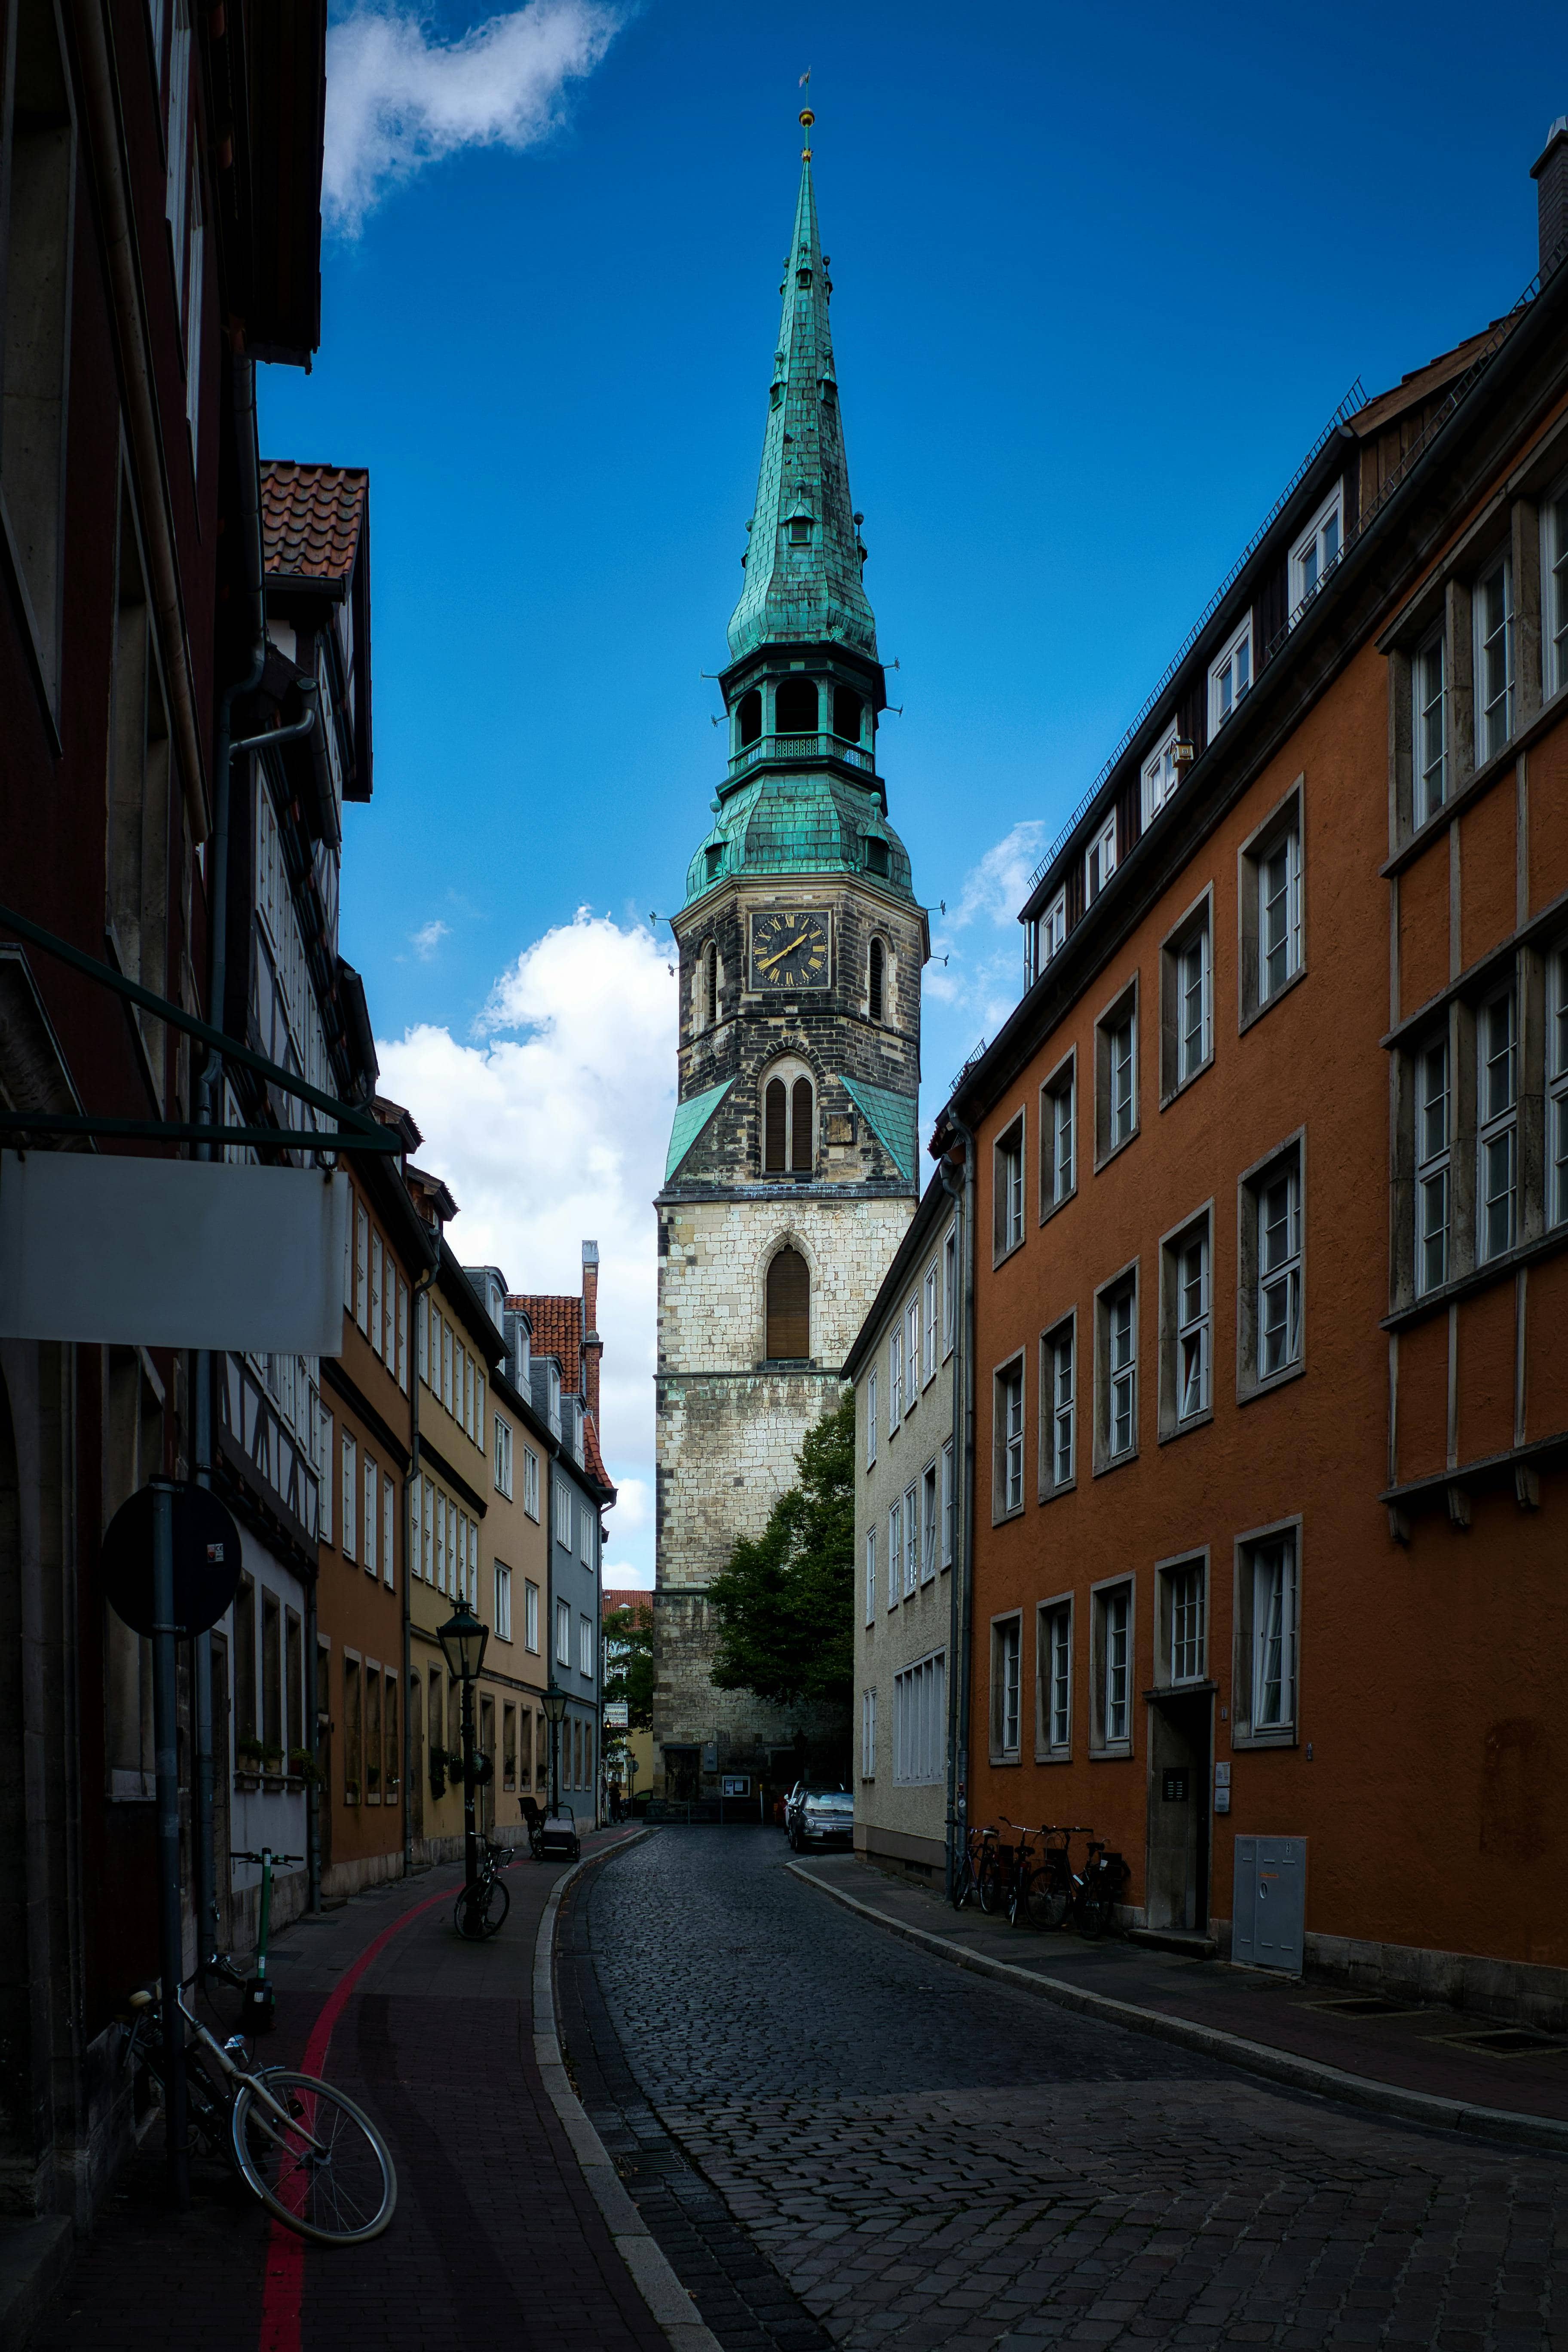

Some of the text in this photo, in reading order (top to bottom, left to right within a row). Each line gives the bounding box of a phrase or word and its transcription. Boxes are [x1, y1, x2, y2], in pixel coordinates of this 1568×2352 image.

[769, 919, 781, 933] XI
[785, 914, 794, 928] XII
[801, 918, 809, 930] I
[758, 929, 772, 941] X
[809, 930, 822, 940] II
[754, 946, 767, 955] IX
